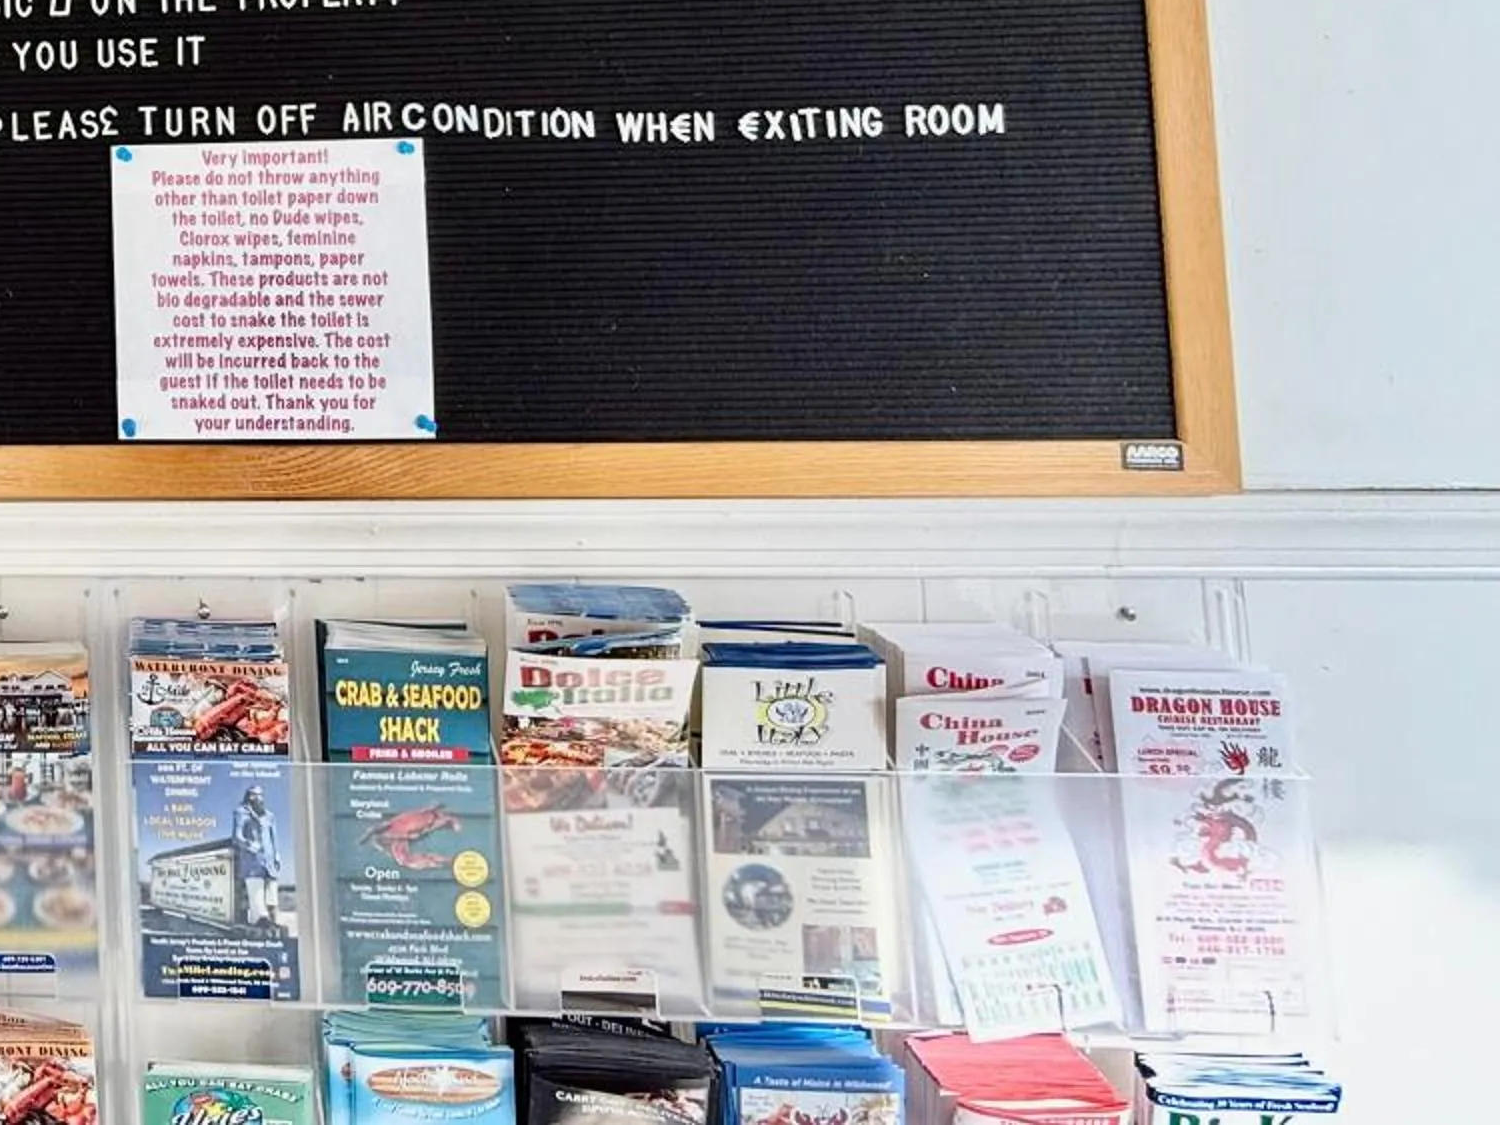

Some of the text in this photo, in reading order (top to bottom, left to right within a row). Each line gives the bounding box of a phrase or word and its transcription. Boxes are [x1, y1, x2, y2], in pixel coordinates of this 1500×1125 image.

[138, 106, 235, 137] TURN
[257, 103, 317, 136] OFF
[904, 102, 1006, 138] ROOM
[201, 150, 237, 168] Very
[152, 169, 381, 186] Please do not throw anything
[209, 272, 254, 286] These
[259, 272, 329, 289] products
[333, 274, 358, 285] are
[362, 273, 388, 286] not
[195, 417, 231, 431] your
[233, 664, 281, 675] DINING
[411, 660, 481, 677] Jersey Fresh
[520, 667, 666, 687] Dolce
[336, 680, 481, 709] CRAB & SEAFOOD
[563, 687, 673, 704] Italia
[754, 677, 836, 703] Little
[1130, 696, 1281, 716] DRAGON HOUSE
[920, 713, 1003, 730] China
[1157, 715, 1196, 724] CHINESE
[380, 716, 440, 743] SHACK
[956, 730, 1039, 745] House
[147, 743, 238, 753] ALL YOU CAN EAT
[365, 867, 400, 881] Open
[804, 1078, 830, 1087] Maine
[555, 1091, 596, 1103] CARRY
[1157, 1094, 1214, 1110] Celebrating
